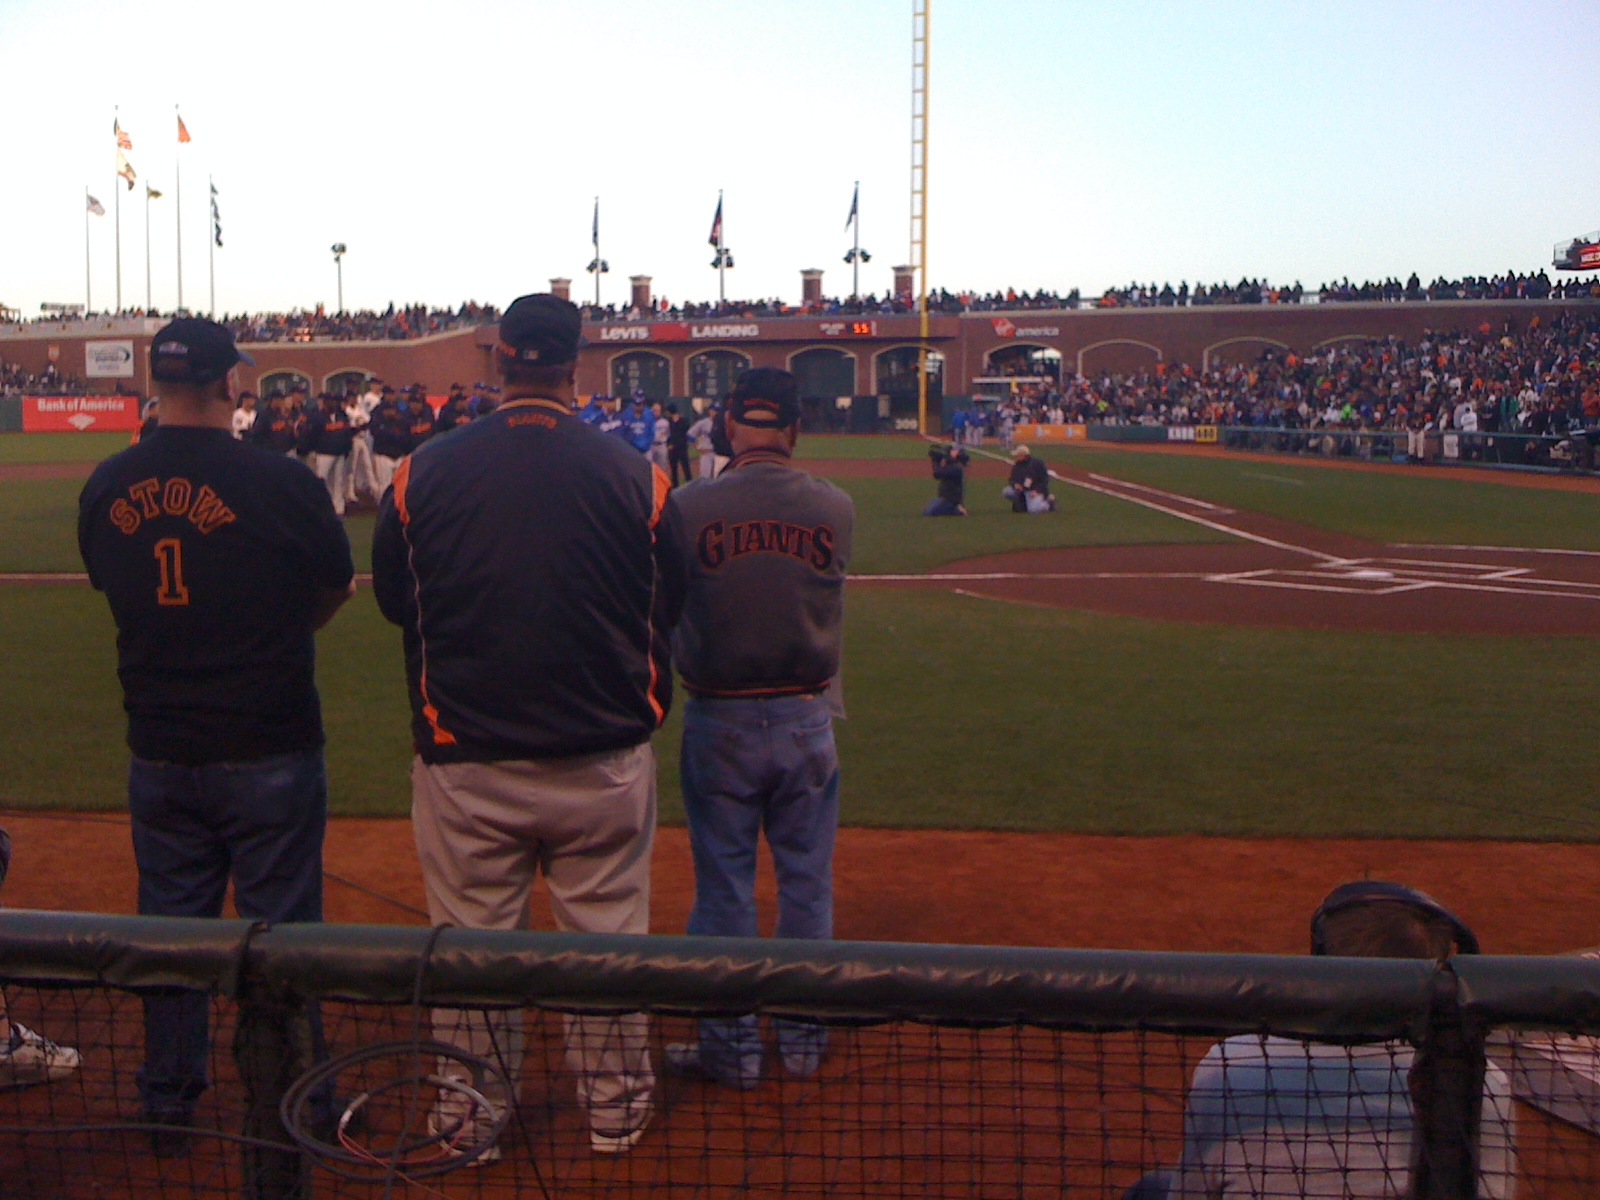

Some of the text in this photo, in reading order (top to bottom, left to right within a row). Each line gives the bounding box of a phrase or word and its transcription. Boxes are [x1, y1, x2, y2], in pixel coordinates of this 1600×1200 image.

[691, 324, 760, 339] LANDING
[1015, 326, 1060, 338] america
[37, 397, 125, 412] Bank of America
[110, 476, 237, 535] STOW
[697, 518, 833, 574] GIANTS
[154, 538, 190, 606] 1
